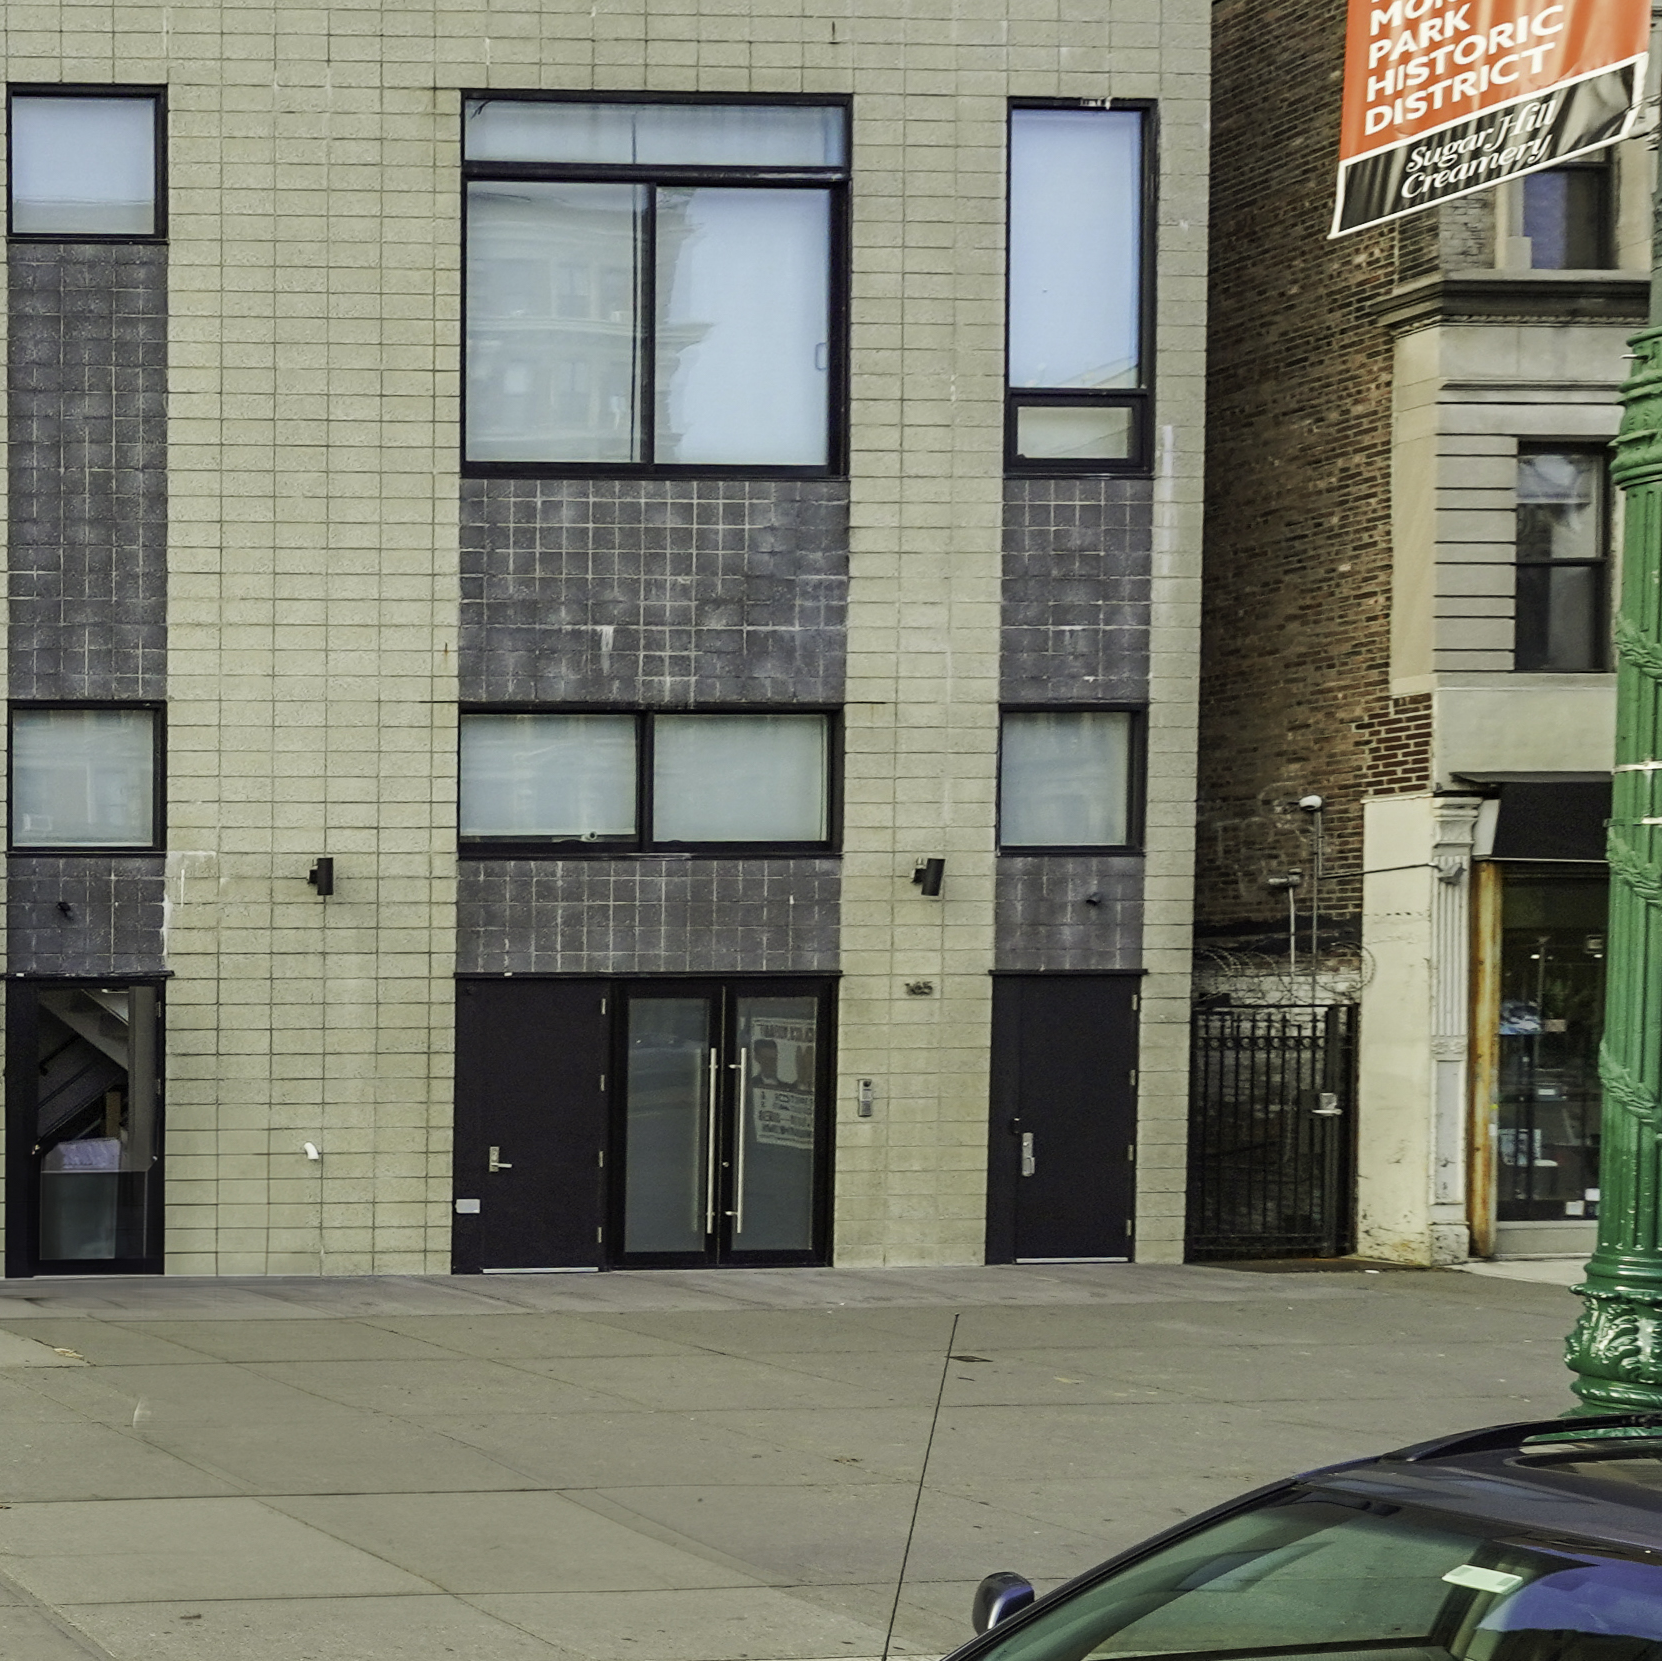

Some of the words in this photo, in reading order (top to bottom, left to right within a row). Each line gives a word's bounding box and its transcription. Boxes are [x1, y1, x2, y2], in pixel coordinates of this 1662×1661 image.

[1366, 4, 1564, 103] HISTORIC
[1368, 2, 1471, 69] PARK
[1364, 42, 1555, 136] DISTRICT
[1401, 134, 1553, 199] Creamery
[1405, 126, 1493, 173] Sugar
[1491, 99, 1557, 153] Hill
